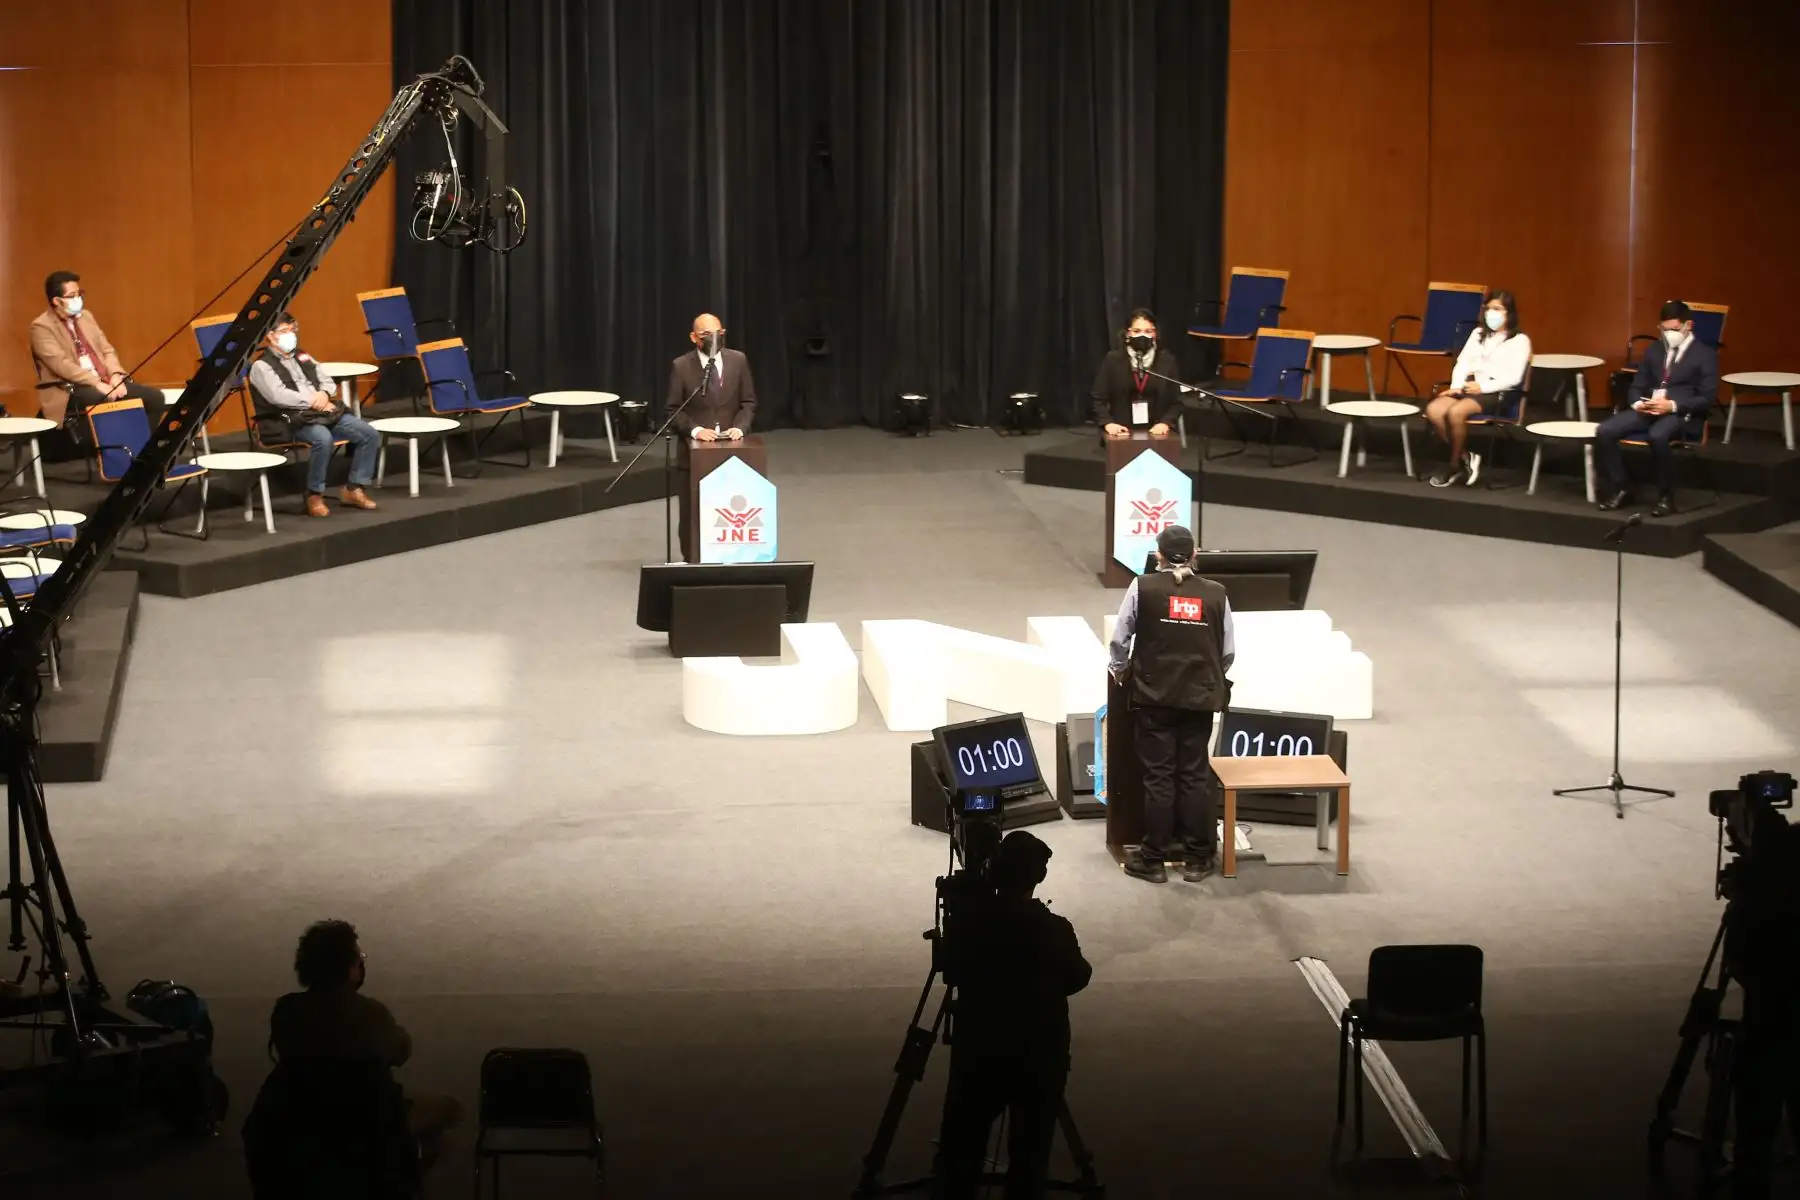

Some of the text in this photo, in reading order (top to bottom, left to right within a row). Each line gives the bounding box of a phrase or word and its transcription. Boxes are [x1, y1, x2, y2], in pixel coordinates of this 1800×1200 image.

[716, 529, 760, 542] JNE
[958, 737, 1024, 776] 01:00
[1231, 730, 1313, 758] 01:00
